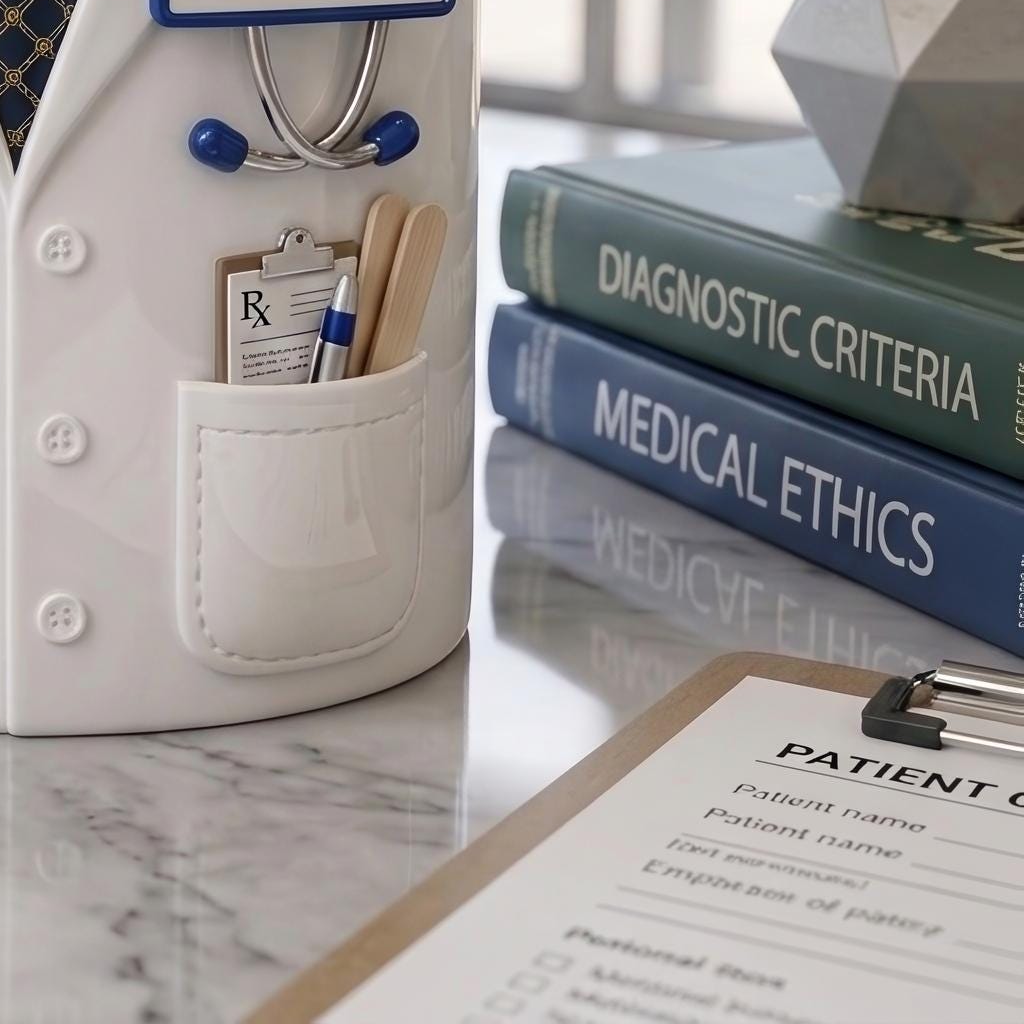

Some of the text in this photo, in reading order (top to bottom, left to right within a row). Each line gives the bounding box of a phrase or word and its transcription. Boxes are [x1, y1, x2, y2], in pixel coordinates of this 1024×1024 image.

[598, 244, 801, 358] DIAGNOSTIC
[810, 315, 980, 421] CRITERIA
[593, 379, 768, 508] MEDICAL
[780, 456, 936, 577] ETHICS
[776, 742, 999, 798] PATIENT
